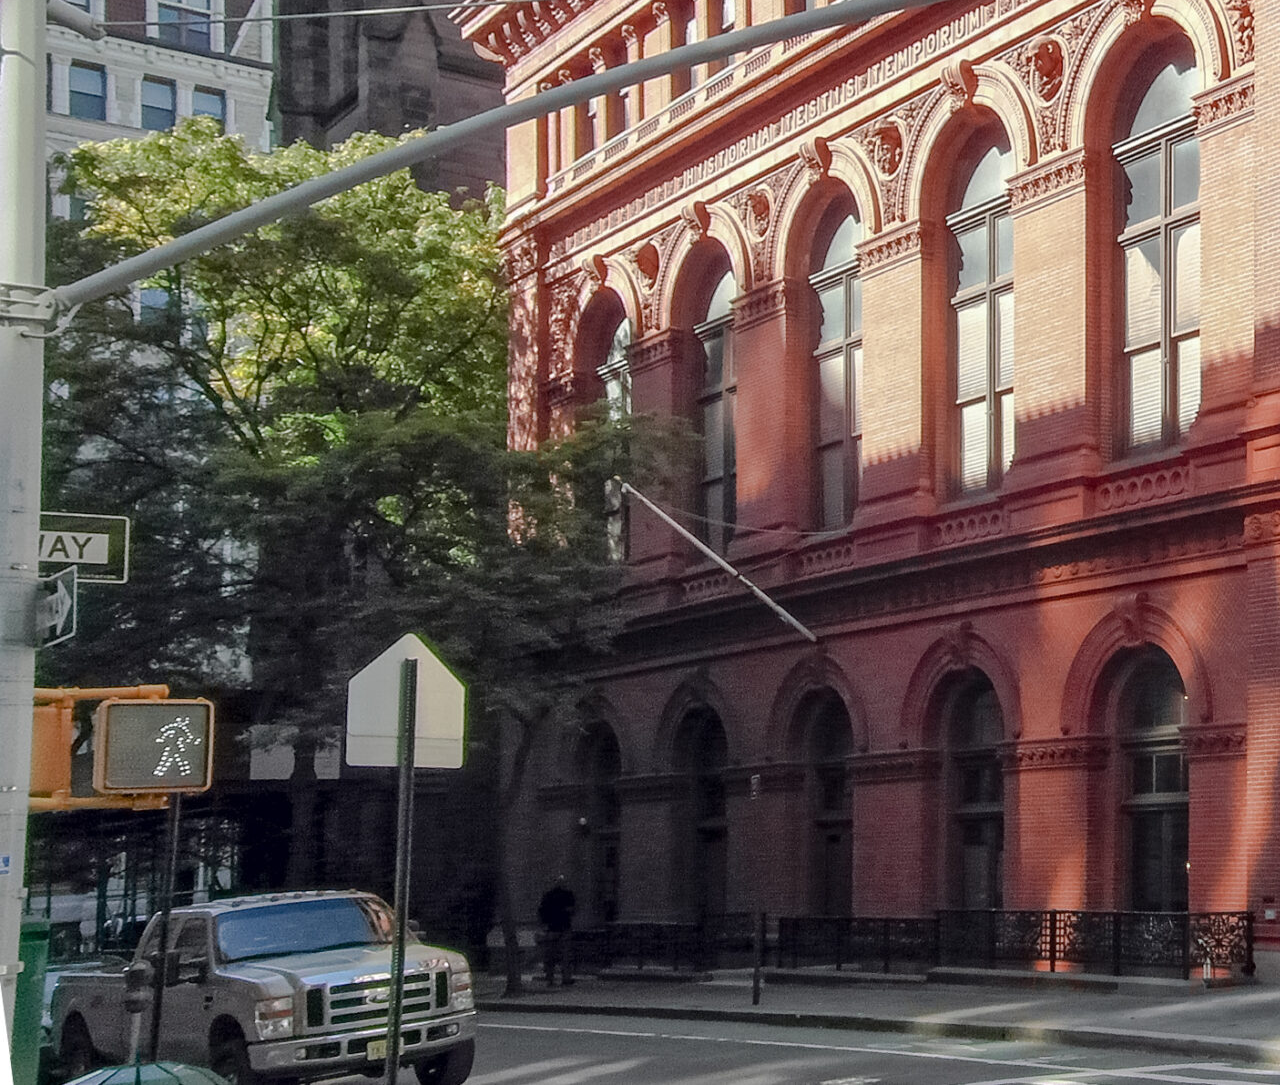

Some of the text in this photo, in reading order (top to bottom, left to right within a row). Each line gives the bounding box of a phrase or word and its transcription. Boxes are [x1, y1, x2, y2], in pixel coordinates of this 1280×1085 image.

[686, 125, 770, 187] HISTORIA
[872, 7, 980, 84] TEMPORUM
[39, 534, 93, 560] AY
